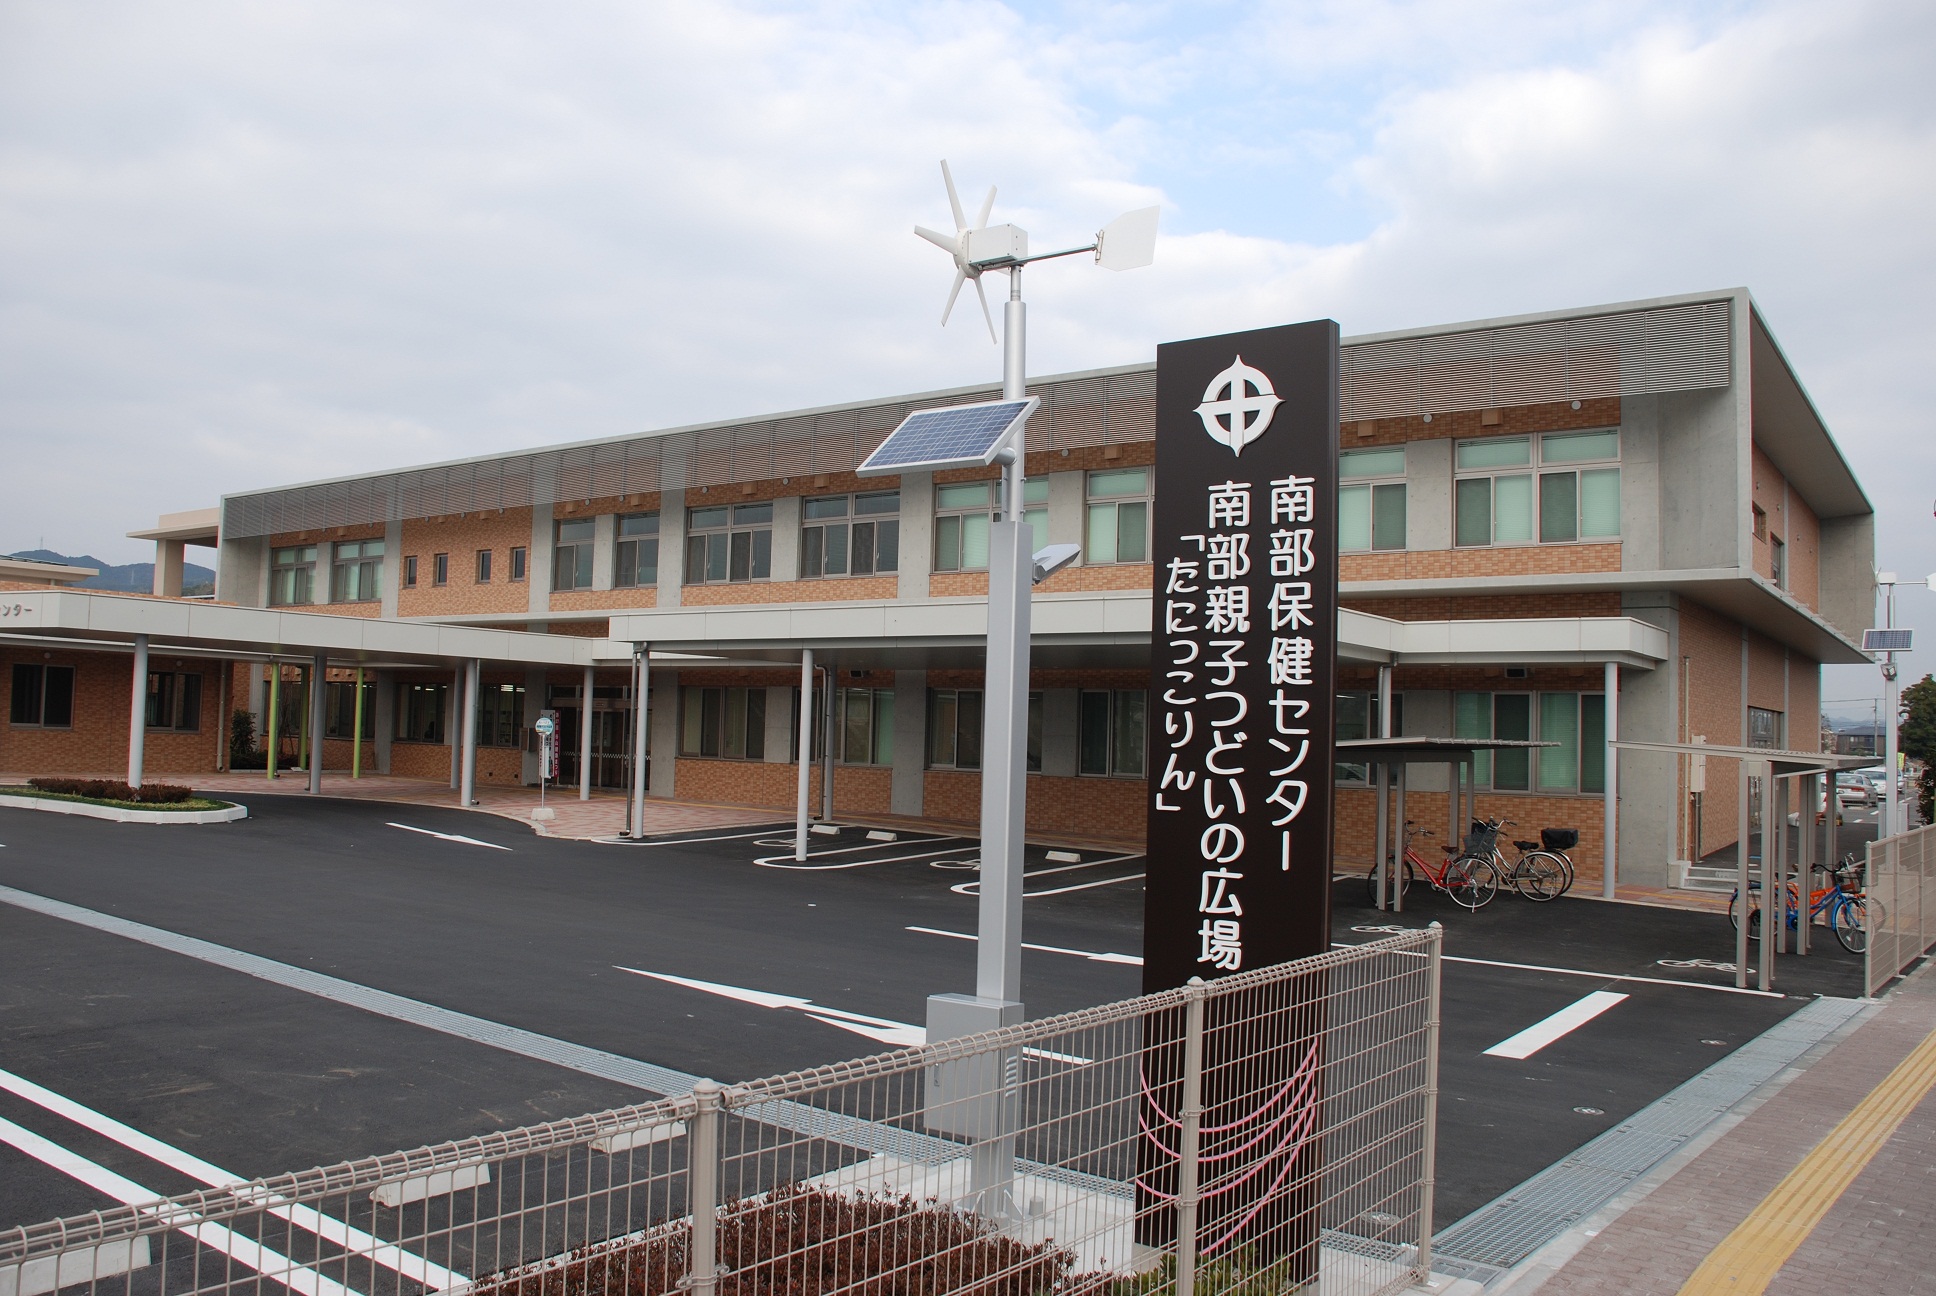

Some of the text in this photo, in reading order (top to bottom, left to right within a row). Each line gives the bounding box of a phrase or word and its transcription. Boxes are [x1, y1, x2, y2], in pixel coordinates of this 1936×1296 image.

[1155, 534, 1206, 812] 「たにっこりん」
[1197, 480, 1252, 971] 南部親子つどいの広場
[1266, 475, 1316, 871] 南部保健センター
